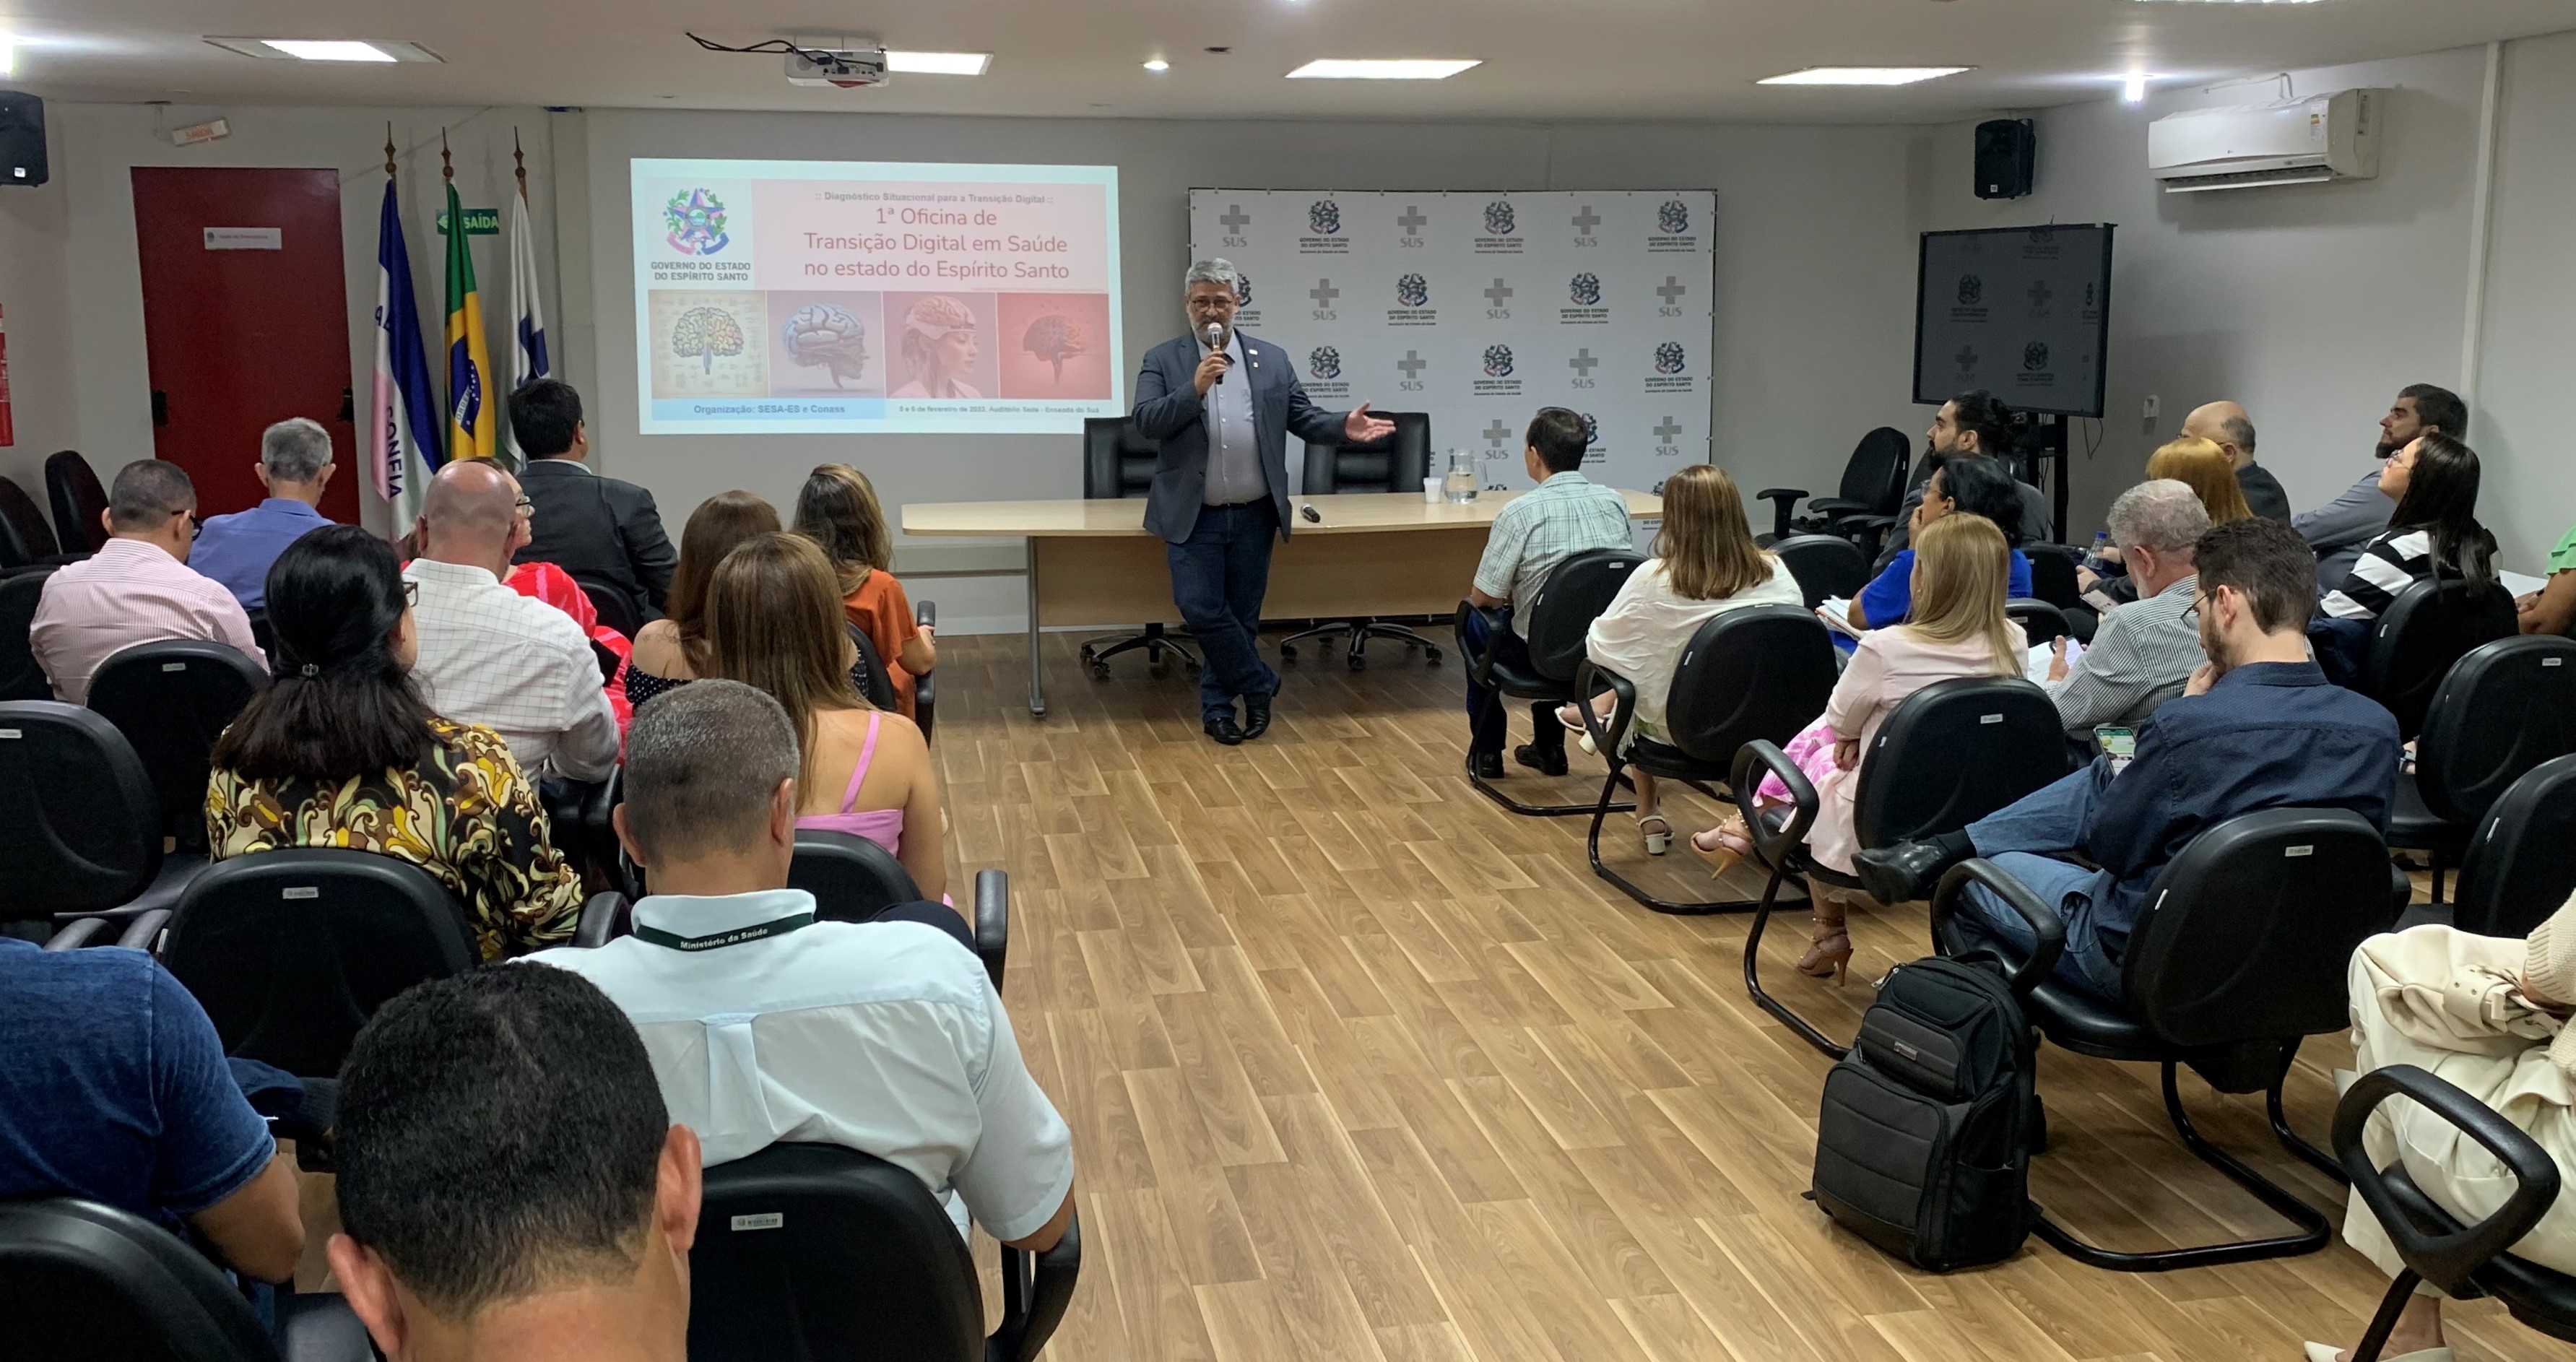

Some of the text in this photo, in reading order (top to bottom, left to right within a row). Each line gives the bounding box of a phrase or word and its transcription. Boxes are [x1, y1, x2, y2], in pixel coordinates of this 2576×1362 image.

[825, 192, 880, 201] Diagnóstico
[882, 193, 934, 201] Situacional
[968, 194, 1012, 204] Transição
[1015, 195, 1045, 204] Digital
[463, 212, 498, 229] SAÍDA
[876, 207, 997, 226] 1ª Oficina de
[804, 232, 1068, 254] Transição Digital em Saúde
[1223, 237, 1247, 248] SUS
[1400, 237, 1424, 248] SUS
[1574, 237, 1597, 248] SUS
[651, 261, 696, 270] GOVERNO
[715, 262, 751, 271] ESTADO
[805, 259, 1070, 281] no estado do Espírito Santo
[671, 271, 714, 280] ESPÍRITO
[1312, 310, 1337, 321] SUS
[1486, 308, 1511, 319] SUS
[1658, 306, 1683, 317] SUS
[1400, 381, 1424, 391] SUS
[1571, 378, 1595, 389] SUS
[694, 405, 755, 415] Organização:
[758, 405, 799, 414] SESA-ES
[810, 405, 845, 414] Conass
[1485, 449, 1509, 460] SUS
[1655, 446, 1679, 456] SUS
[680, 928, 768, 949] Ministério da Saúde
